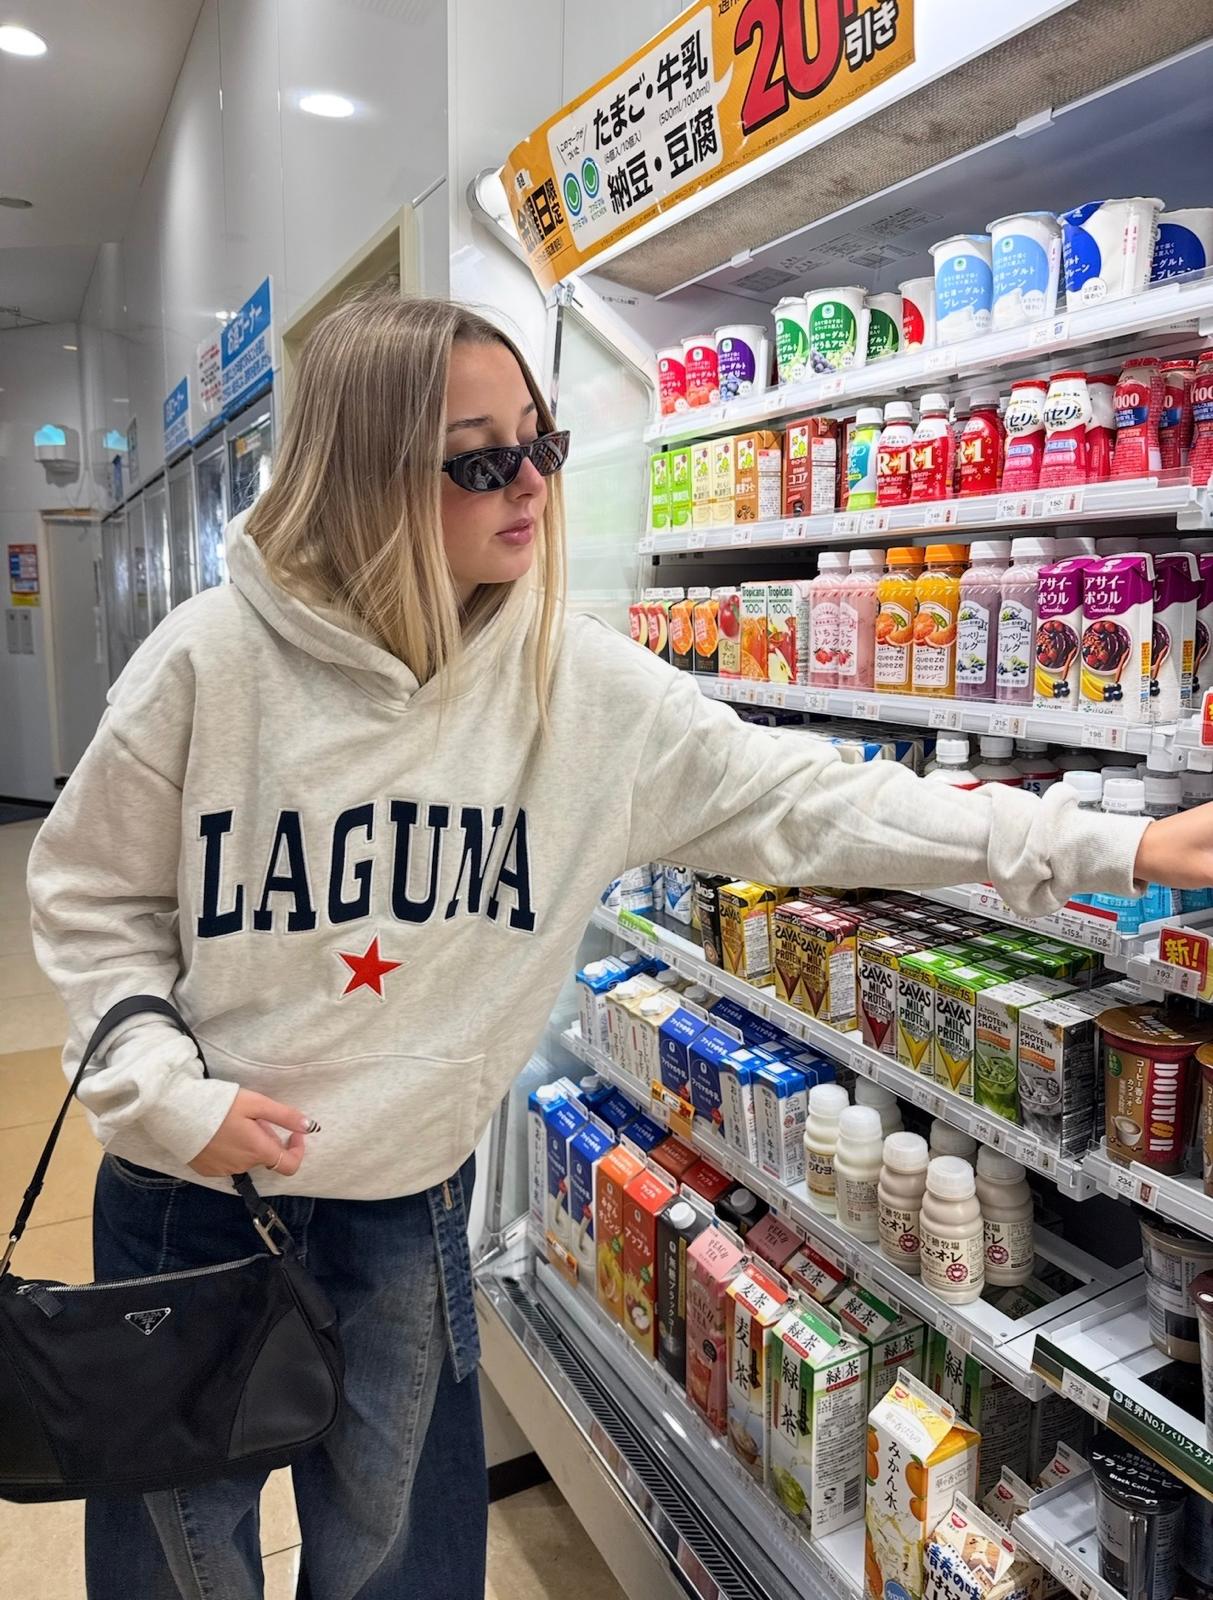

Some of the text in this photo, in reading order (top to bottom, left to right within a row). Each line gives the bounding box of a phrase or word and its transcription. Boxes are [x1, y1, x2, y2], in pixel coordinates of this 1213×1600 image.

[593, 29, 708, 150] たまご・牛乳
[606, 104, 718, 215] 納豆・豆腐
[788, 471, 808, 485] ココア
[741, 585, 765, 597] Tropicana
[768, 586, 793, 597] Tropicana
[1038, 577, 1073, 591] アサイー
[1084, 575, 1126, 591] アサイー
[196, 798, 537, 939] LAGUNA
[801, 937, 827, 961] SAVAS
[807, 952, 823, 967] MILK
[1164, 937, 1200, 968] 新!
[862, 964, 893, 990] SAVAS
[868, 981, 888, 997] MILK
[862, 990, 893, 1012] PROTEIN
[899, 979, 931, 1008] SAVAS
[899, 1006, 931, 1030] PROTEIN
[906, 998, 925, 1017] MILK
[936, 997, 972, 1027] SAVAS
[944, 1016, 965, 1036] MILK
[978, 1012, 1009, 1029] PROTEIN
[978, 1020, 1002, 1035] SHAKE
[937, 1025, 971, 1052] PROTEIN
[1020, 1031, 1053, 1050] PROTEIN
[1020, 1039, 1045, 1054] SHAKE
[1134, 1059, 1145, 1105] コーヒー香る
[705, 1248, 718, 1262] TEA
[708, 1239, 729, 1260] PEACH
[797, 1262, 826, 1287] 麦茶
[740, 1282, 770, 1309] 麦茶
[844, 1296, 879, 1327] 緑茶
[787, 1319, 820, 1352] 緑茶
[883, 1333, 915, 1359] 緑茶
[735, 1316, 749, 1391] 麦茶
[825, 1360, 860, 1386] 緑茶
[781, 1355, 800, 1438] 緑茶
[883, 1440, 901, 1511] みかん水
[1092, 1451, 1184, 1490] ブラックコーヒー
[1108, 1473, 1157, 1495] Black Coffee
[927, 1543, 981, 1600] 青春の味
